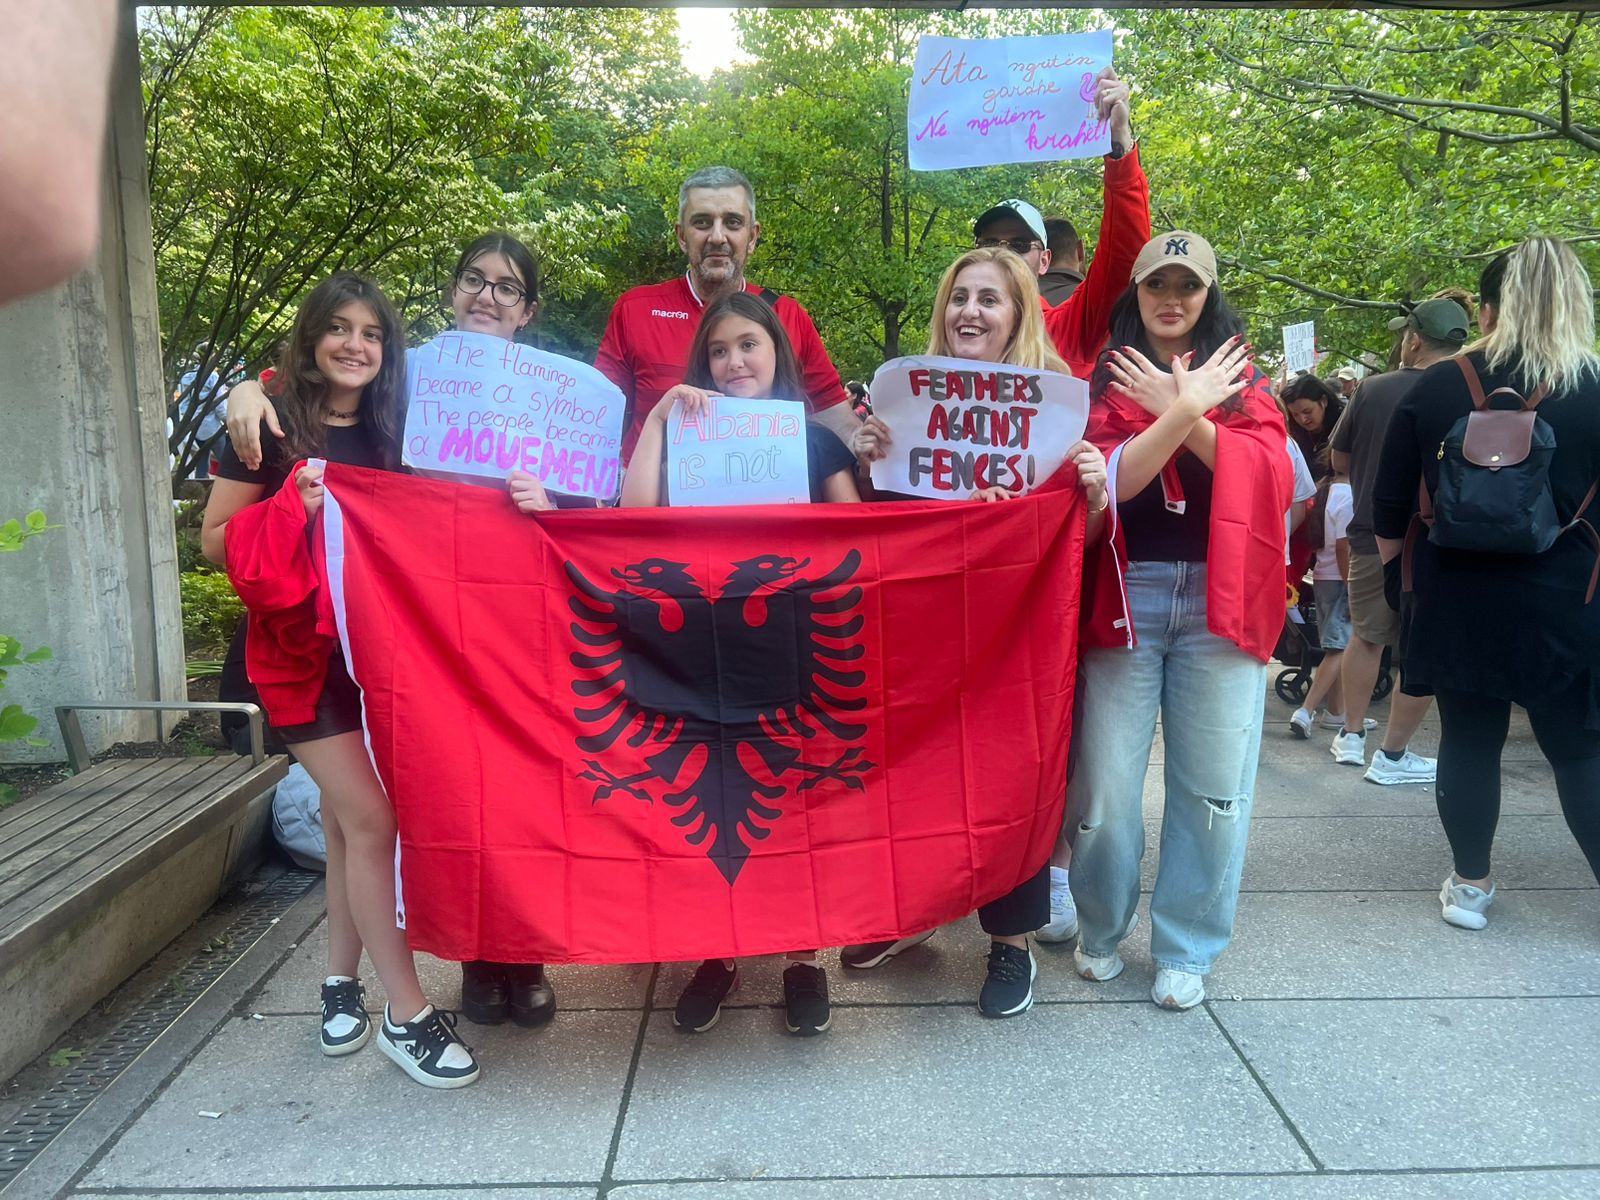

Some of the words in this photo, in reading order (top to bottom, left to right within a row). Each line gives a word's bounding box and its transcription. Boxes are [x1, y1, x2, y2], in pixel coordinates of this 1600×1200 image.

[921, 50, 989, 86] Ata
[916, 110, 949, 141] Ne
[1165, 238, 1189, 256] NY
[652, 309, 689, 320] macron
[437, 335, 485, 368] The
[499, 342, 576, 395] flamingo
[416, 365, 482, 399] became
[493, 384, 515, 403] a
[528, 391, 608, 428] symbol
[908, 369, 1043, 404] FEATHERS
[416, 400, 460, 427] The
[468, 410, 536, 436] people
[673, 400, 800, 445] Albania
[927, 403, 1038, 450] AGAINST
[409, 435, 429, 456] a
[678, 453, 706, 490] is
[725, 445, 782, 484] not
[908, 447, 1036, 494] FENCES!
